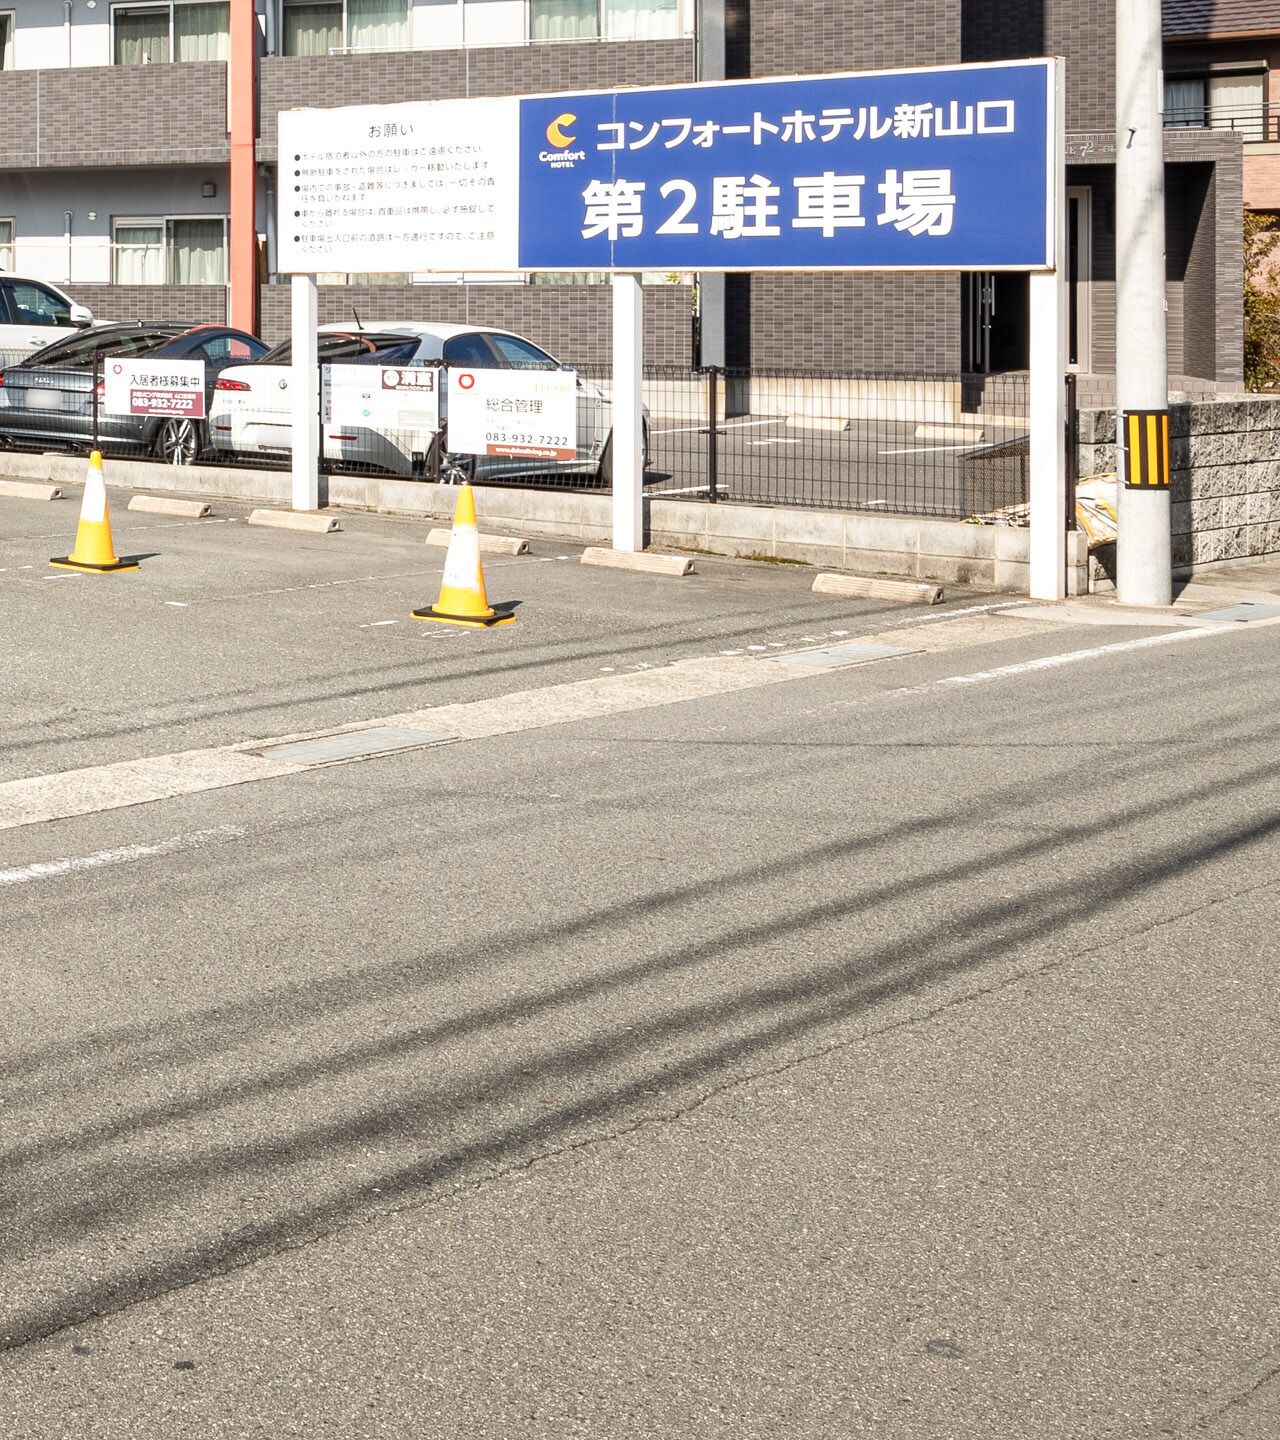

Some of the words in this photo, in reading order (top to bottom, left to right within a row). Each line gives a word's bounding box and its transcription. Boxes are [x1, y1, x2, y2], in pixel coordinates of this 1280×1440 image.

[368, 122, 416, 138] お願い
[595, 98, 1016, 152] コンフォートホテル新山口
[538, 150, 586, 162] Comfort
[580, 168, 957, 241] 第2駐車場
[130, 374, 200, 388] 入居者様募集中
[132, 397, 194, 409] 083-932-7222
[486, 398, 544, 414] 総合管理
